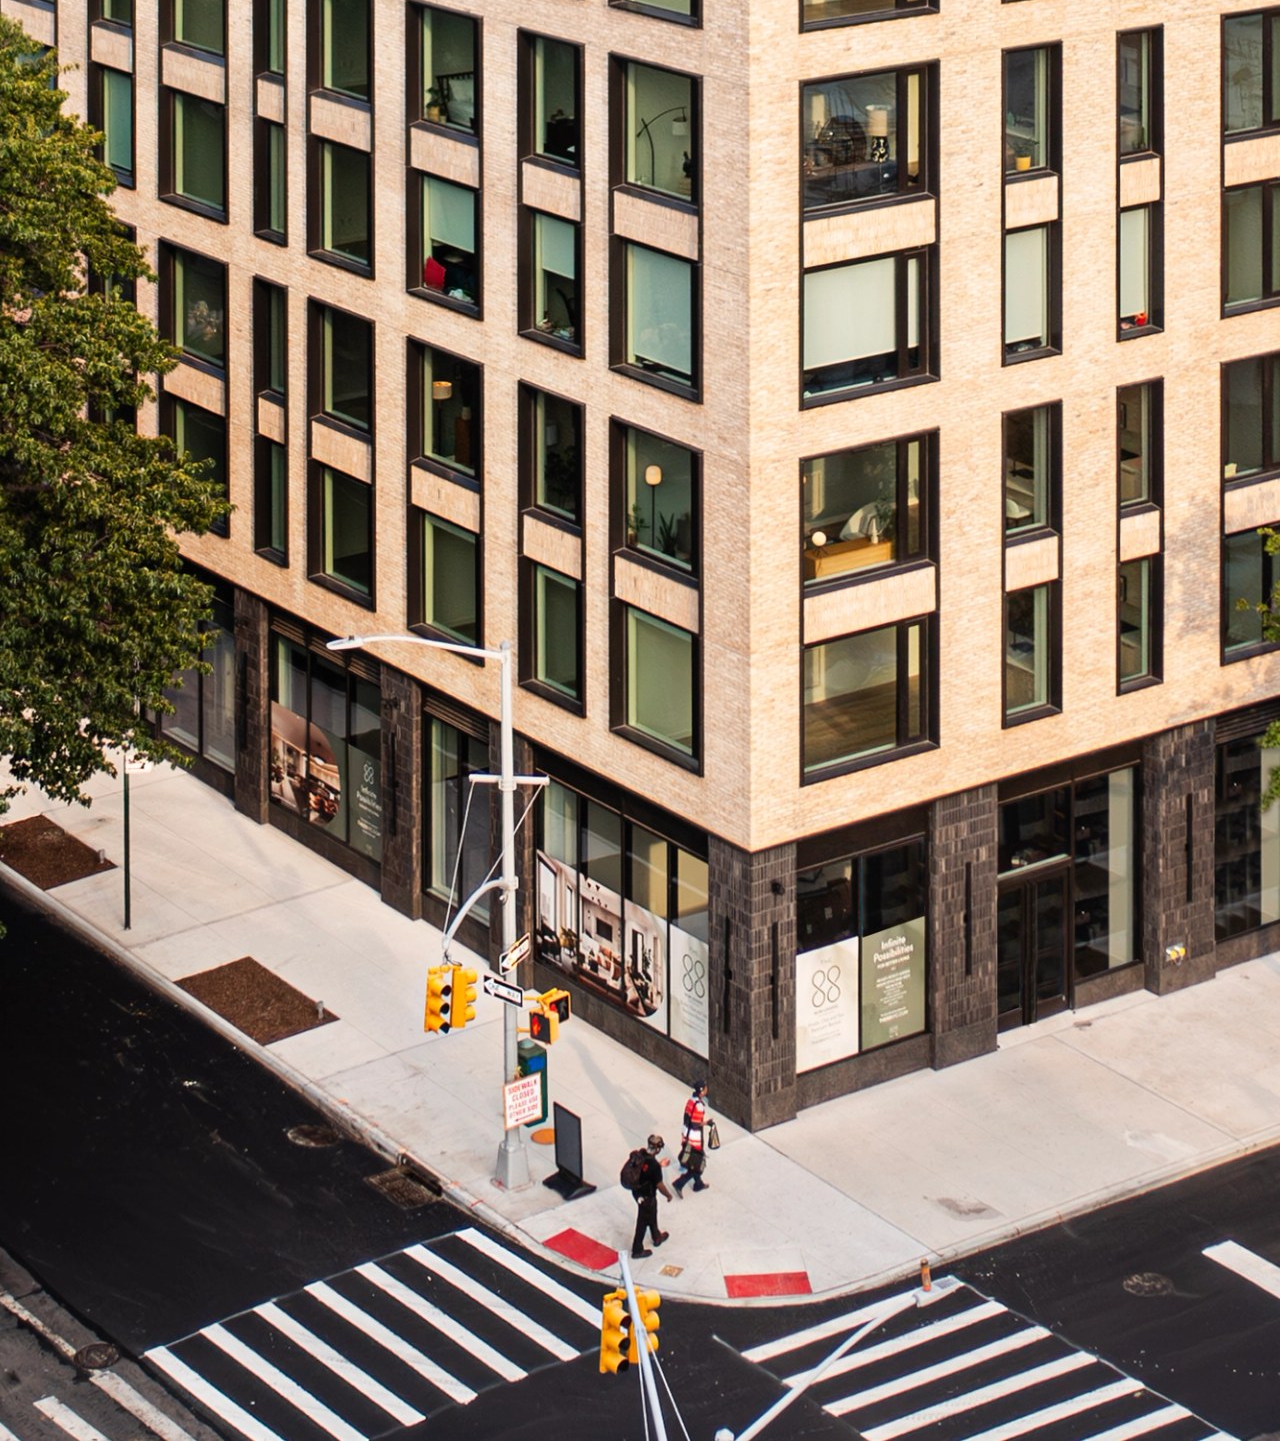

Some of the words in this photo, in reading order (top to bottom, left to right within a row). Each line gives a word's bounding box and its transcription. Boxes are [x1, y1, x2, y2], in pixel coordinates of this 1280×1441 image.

[873, 944, 914, 964] Possibilities
[812, 965, 841, 1008] 88
[508, 1079, 537, 1094] SIDEWALK
[512, 1088, 535, 1102] CLOSED
[509, 1099, 527, 1111] PLEASE
[510, 1107, 526, 1118] OTHER
